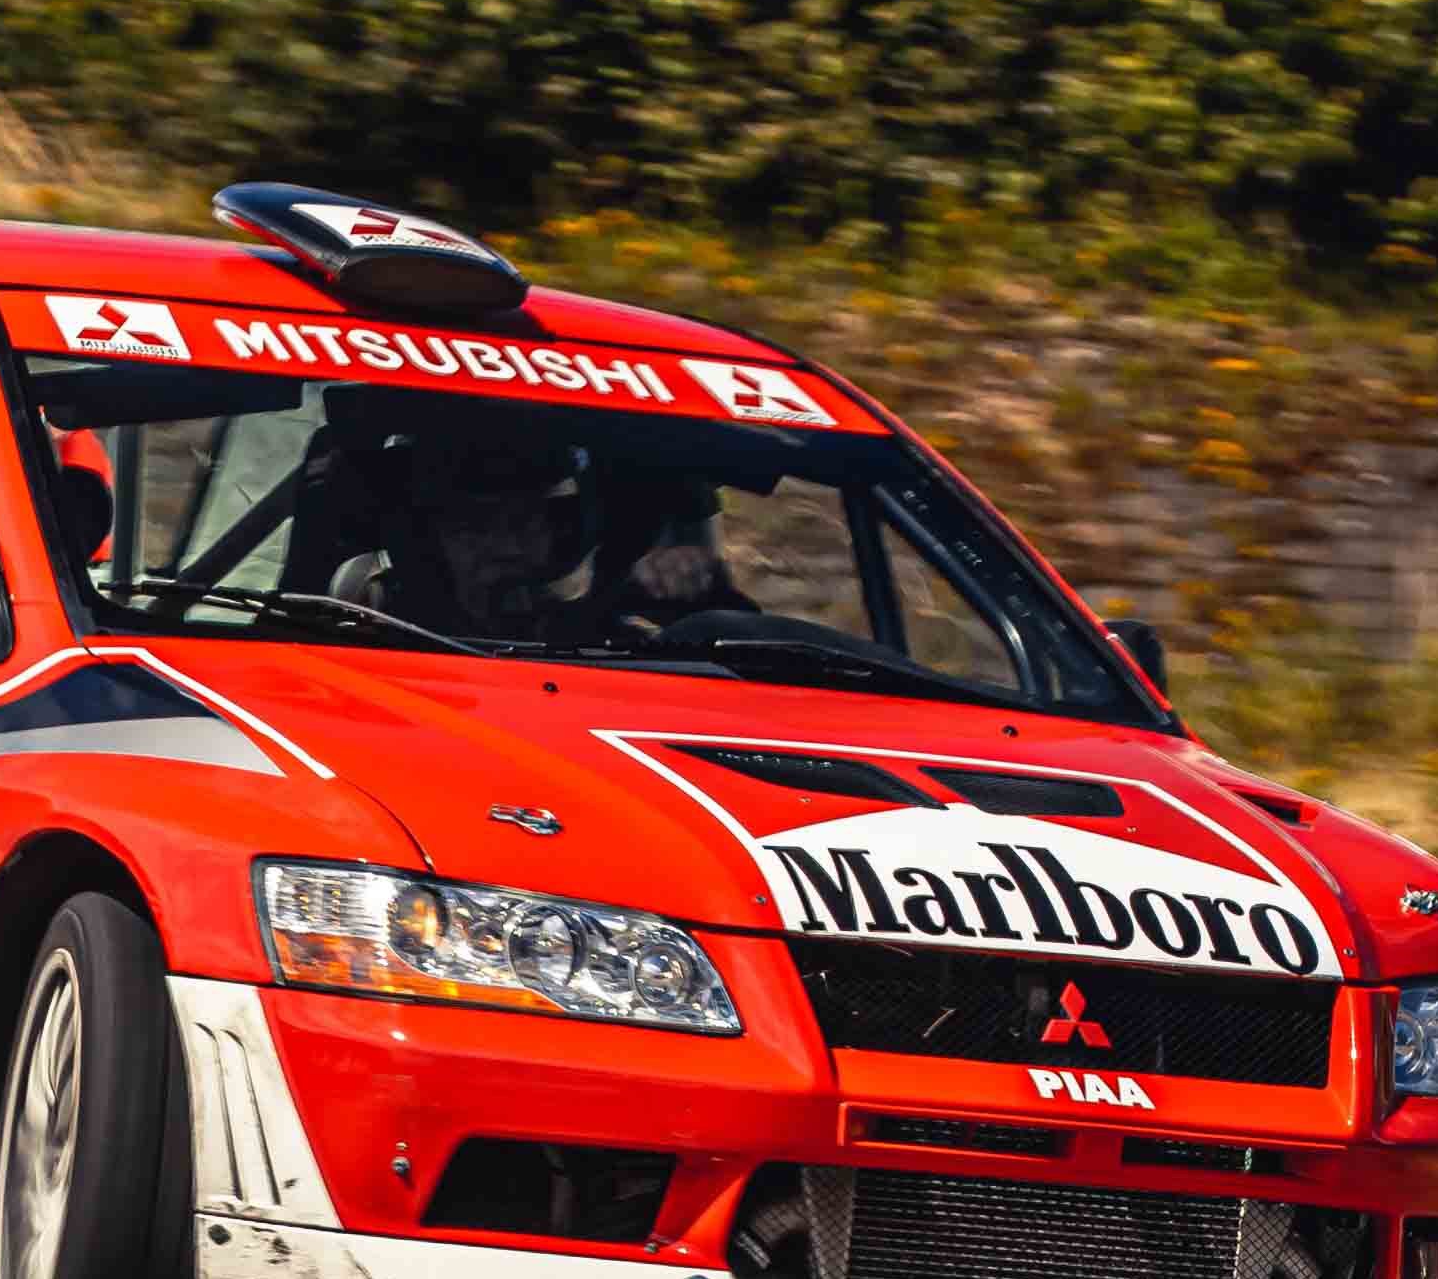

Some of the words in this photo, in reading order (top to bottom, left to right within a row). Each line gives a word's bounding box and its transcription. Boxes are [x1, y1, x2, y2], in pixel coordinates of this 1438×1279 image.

[213, 318, 676, 403] MITSUBISHI
[762, 841, 1320, 976] Marlboro
[1027, 1068, 1156, 1110] PIAA
